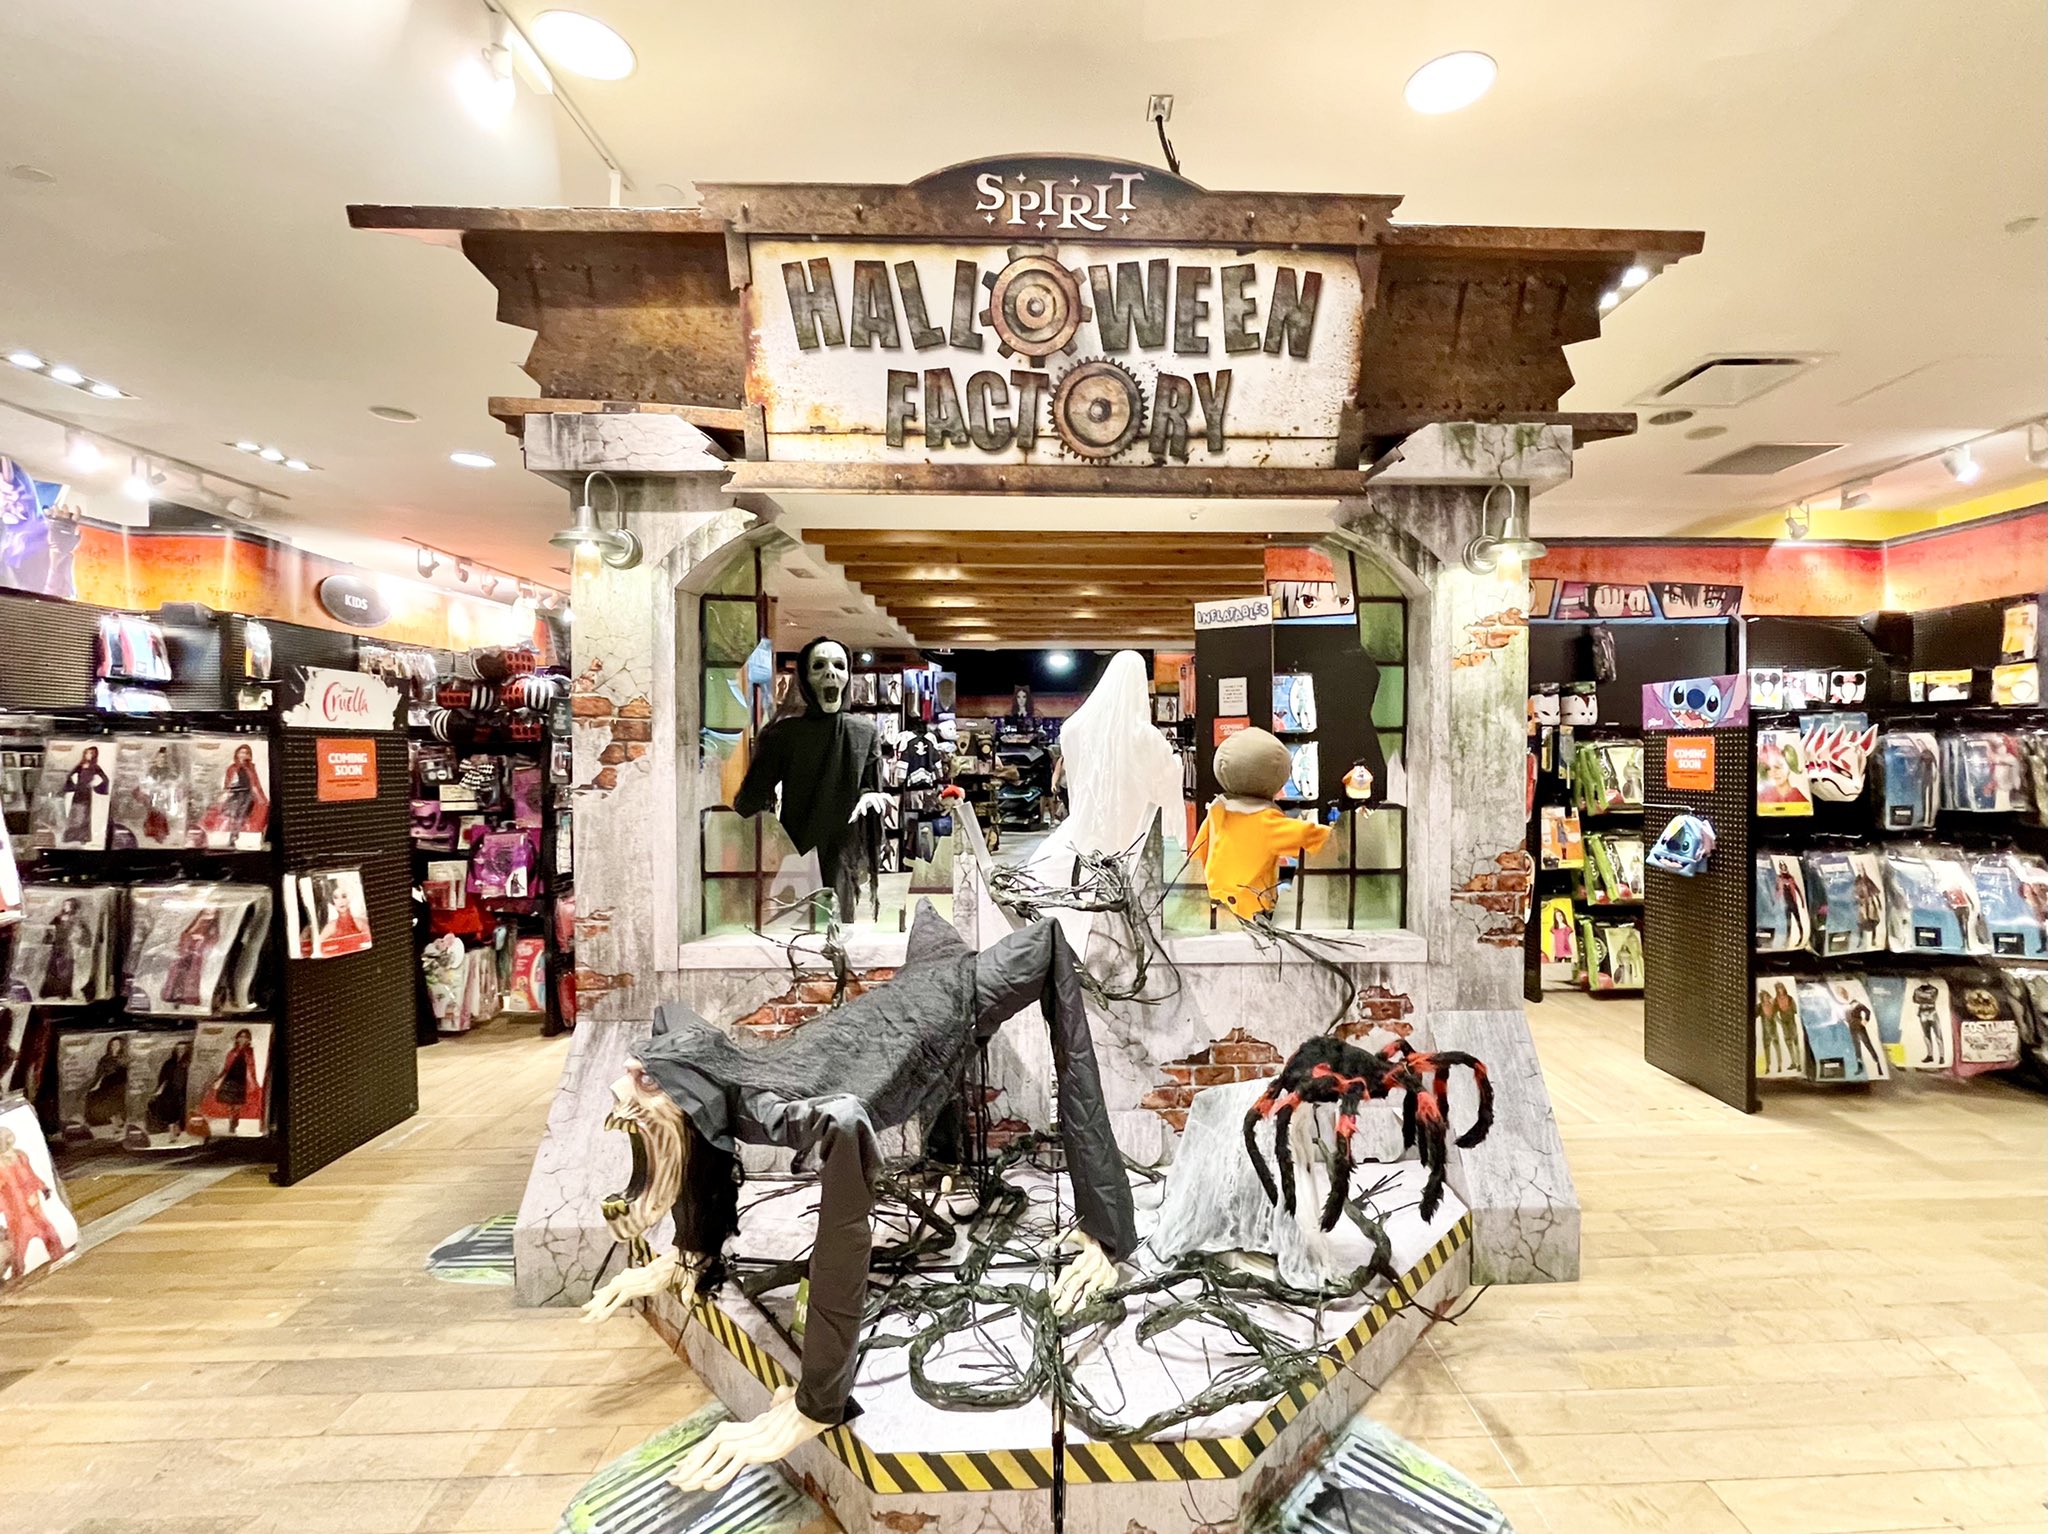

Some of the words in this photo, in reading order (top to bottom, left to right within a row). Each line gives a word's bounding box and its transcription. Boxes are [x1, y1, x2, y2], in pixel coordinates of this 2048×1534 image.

[975, 172, 1145, 231] SPIRIT
[781, 246, 1322, 364] HALLOWEEN
[886, 357, 1232, 463] FACTORY
[344, 594, 368, 610] KIDS
[1197, 603, 1268, 624] INFLATABLES
[323, 682, 369, 721] Cruella
[327, 753, 369, 764] COMING
[1673, 749, 1707, 759] COMING
[335, 765, 363, 776] SOON
[1678, 759, 1701, 768] SOON
